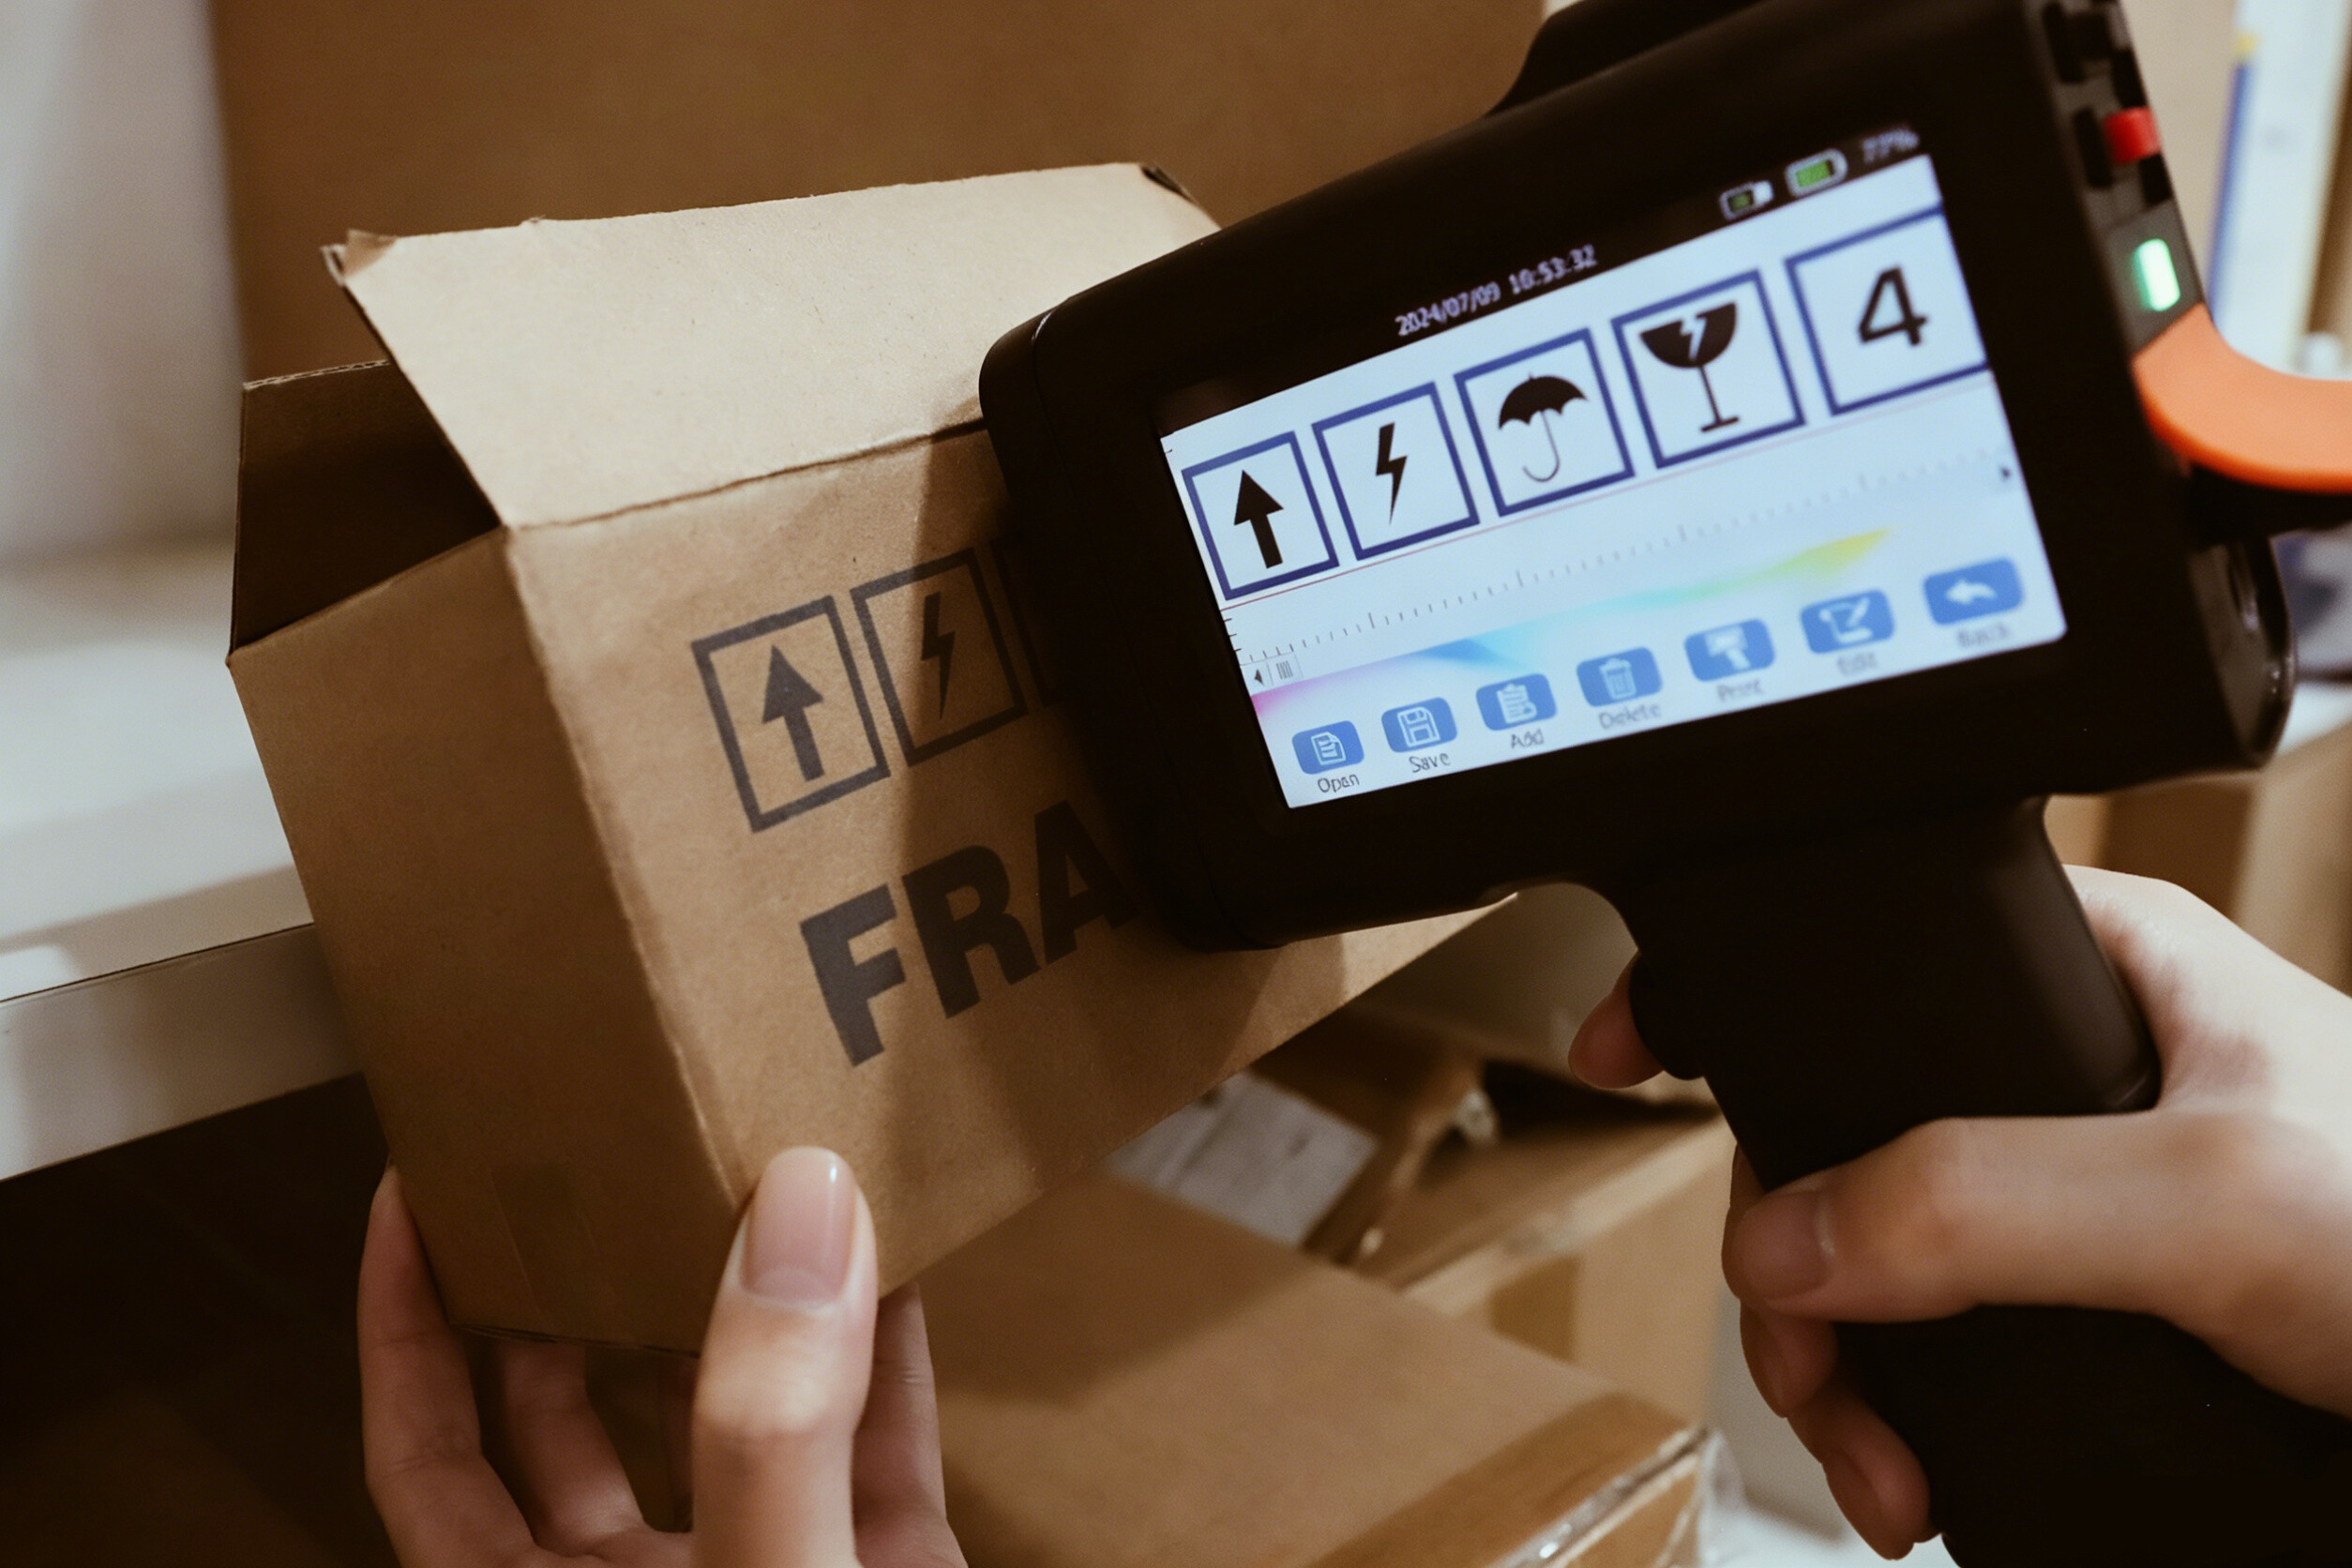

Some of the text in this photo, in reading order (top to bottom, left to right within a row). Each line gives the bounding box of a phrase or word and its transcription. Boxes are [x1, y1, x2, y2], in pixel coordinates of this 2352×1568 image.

[1395, 280, 1501, 337] 2024/07/09
[1858, 266, 1928, 347] 4
[1318, 773, 1360, 793] Open
[1409, 752, 1451, 774] Save
[1511, 728, 1545, 750] Add
[1599, 701, 1662, 731] Delete
[1717, 677, 1764, 702] Print
[799, 799, 1140, 1067] FRA
